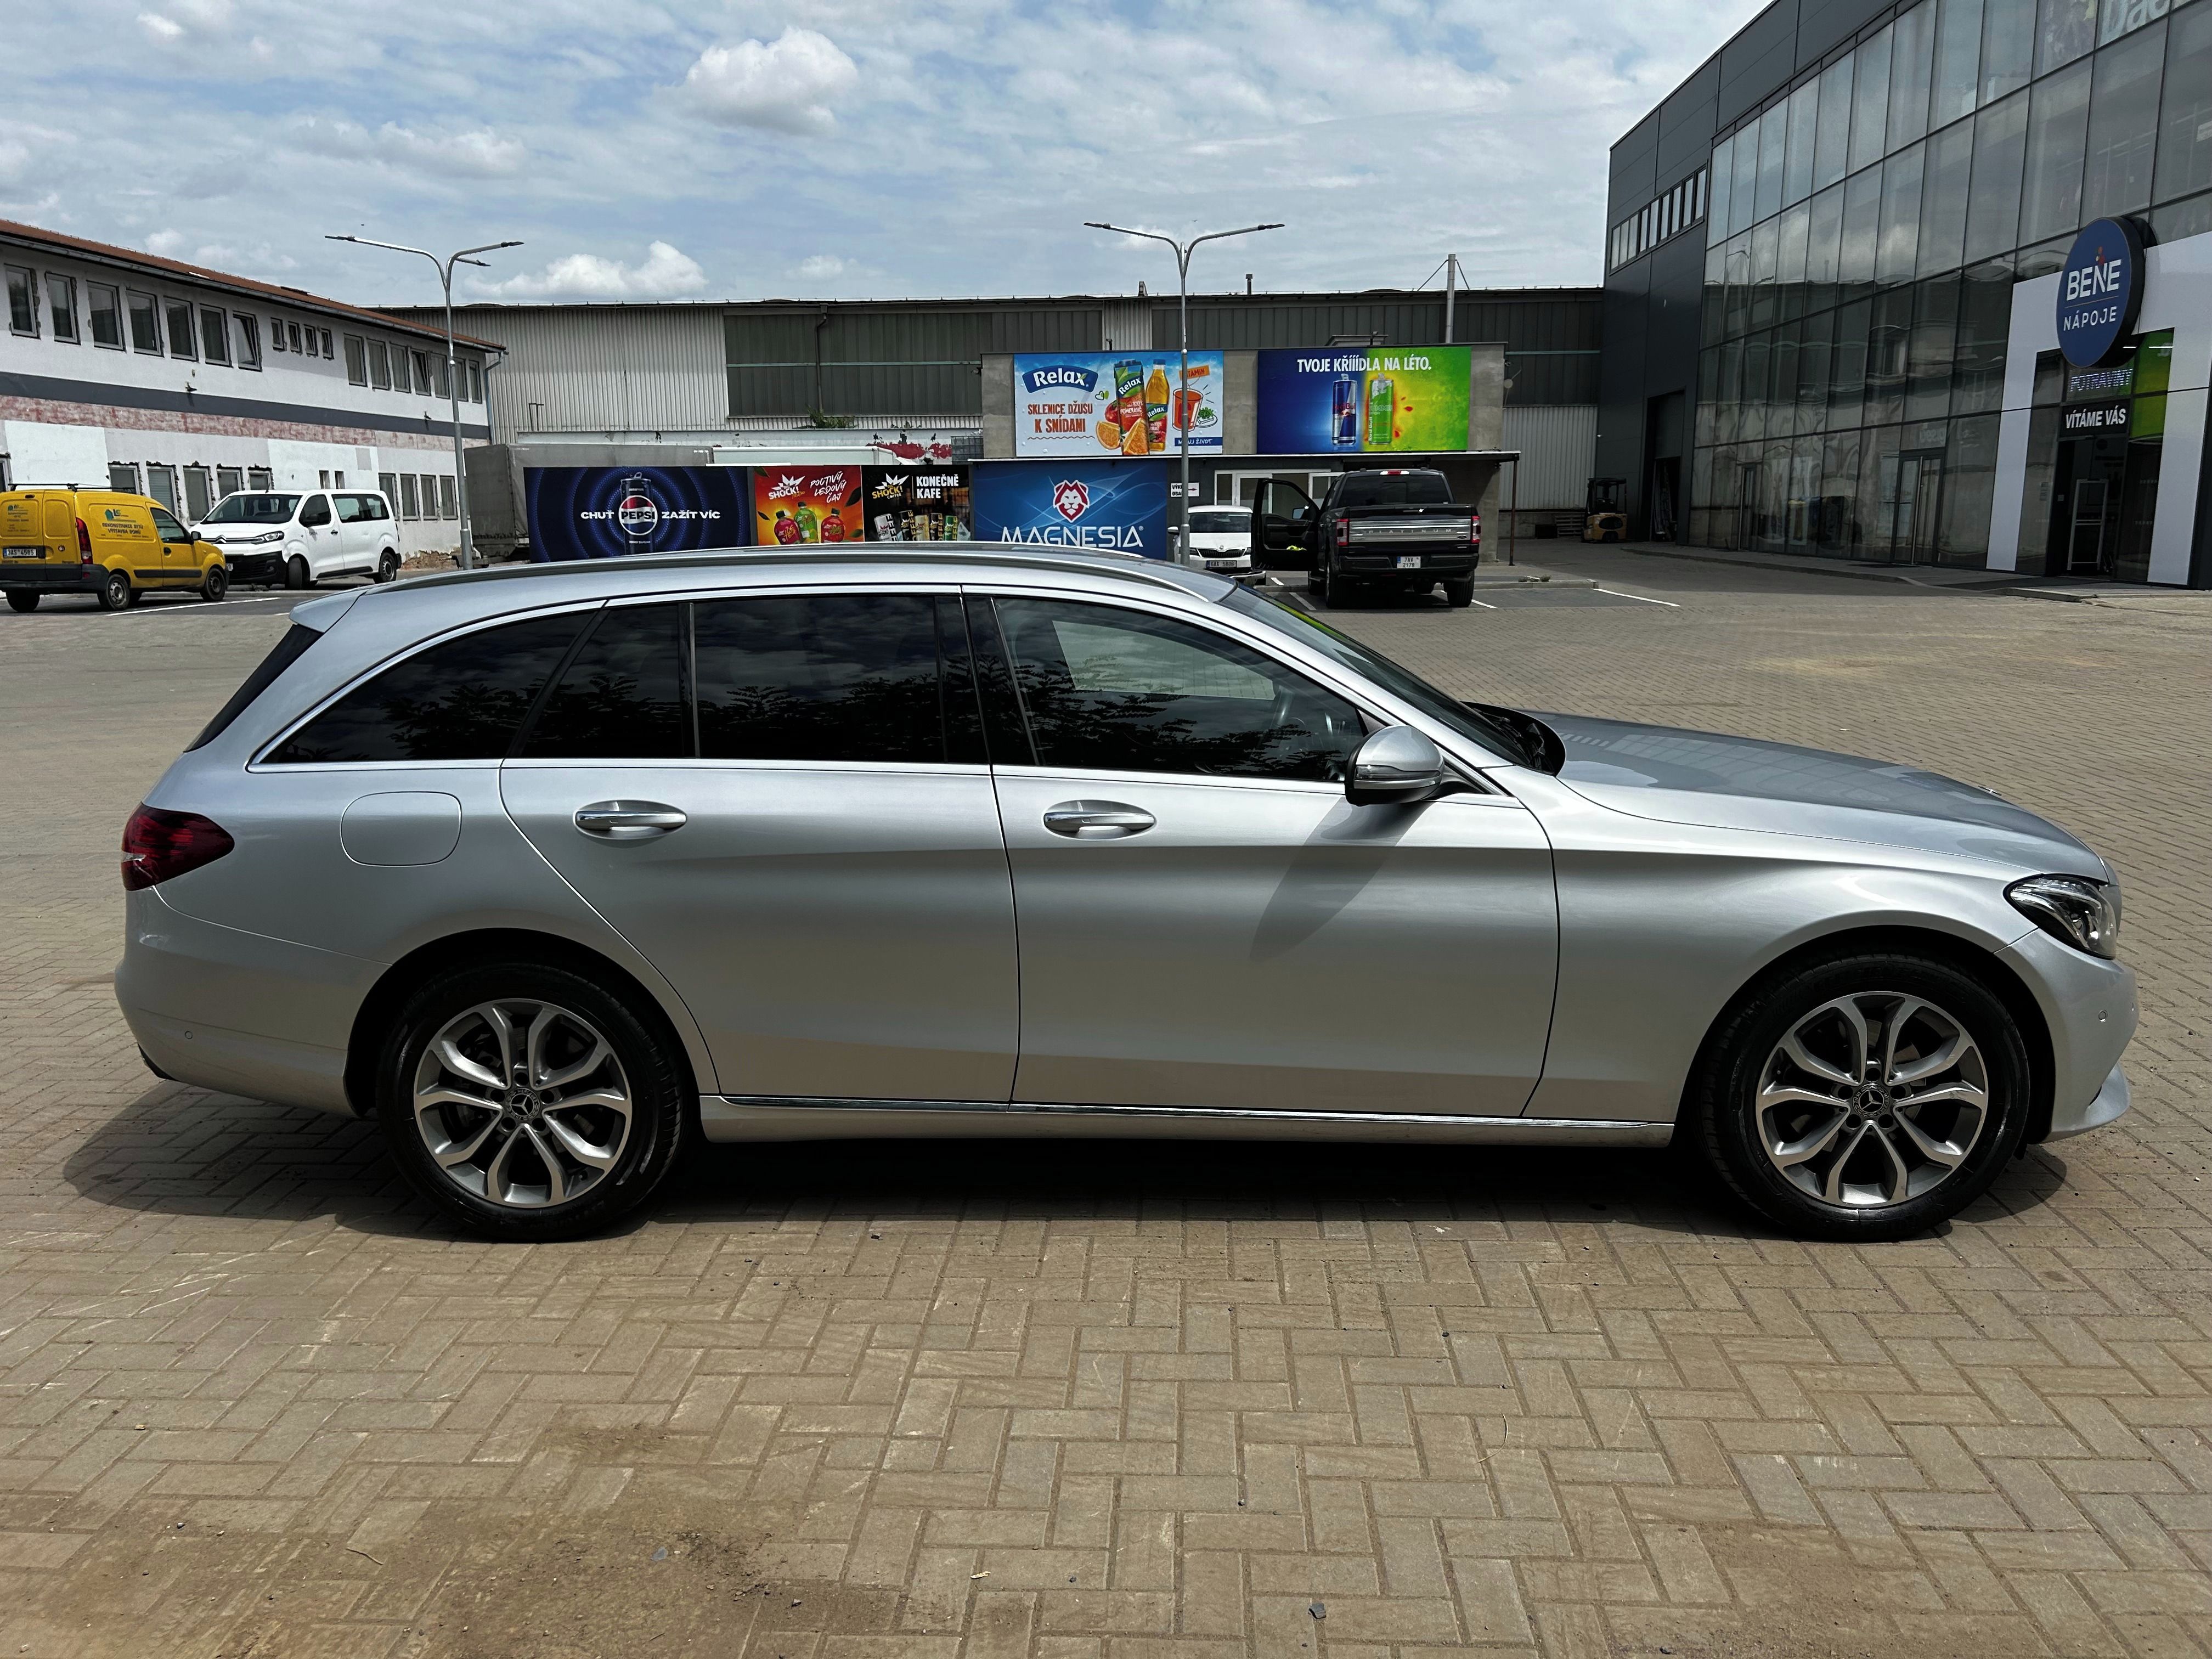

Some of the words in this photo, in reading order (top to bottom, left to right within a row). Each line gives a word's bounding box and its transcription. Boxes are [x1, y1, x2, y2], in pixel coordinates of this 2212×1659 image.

[2066, 259, 2122, 301] BENE
[2063, 306, 2118, 331] NÁPOJE
[1297, 359, 1330, 373] TVOJE
[1334, 354, 1380, 372] KŘÍÍÍDLA
[1384, 357, 1401, 371] NA
[1403, 353, 1432, 371] LÉTO.
[1033, 368, 1086, 387] Relax
[1188, 368, 1205, 377] TAMIN
[1118, 377, 1142, 396] Relax
[1028, 403, 1065, 415] SKLENICE
[1068, 400, 1093, 414] DŽUSU
[1147, 407, 1165, 418] Relax
[1034, 419, 1042, 433] K
[1045, 414, 1086, 433] SNÍDANI
[2066, 409, 2103, 429] VÍTÁME
[2106, 405, 2126, 426] VÁS
[810, 471, 843, 489] POCTIVÝ
[814, 479, 847, 496] LEDOVÝ
[769, 486, 800, 500] SHOCK!
[826, 492, 843, 503] ČAJ
[872, 485, 903, 499] SHOCK!
[917, 488, 941, 499] KAFE
[580, 510, 614, 520] CHUŤ
[661, 509, 698, 519] ZAŽÍT
[699, 509, 720, 519] VÍC
[621, 510, 656, 520] PEPSI
[1001, 526, 1144, 548] MAGNESIA
